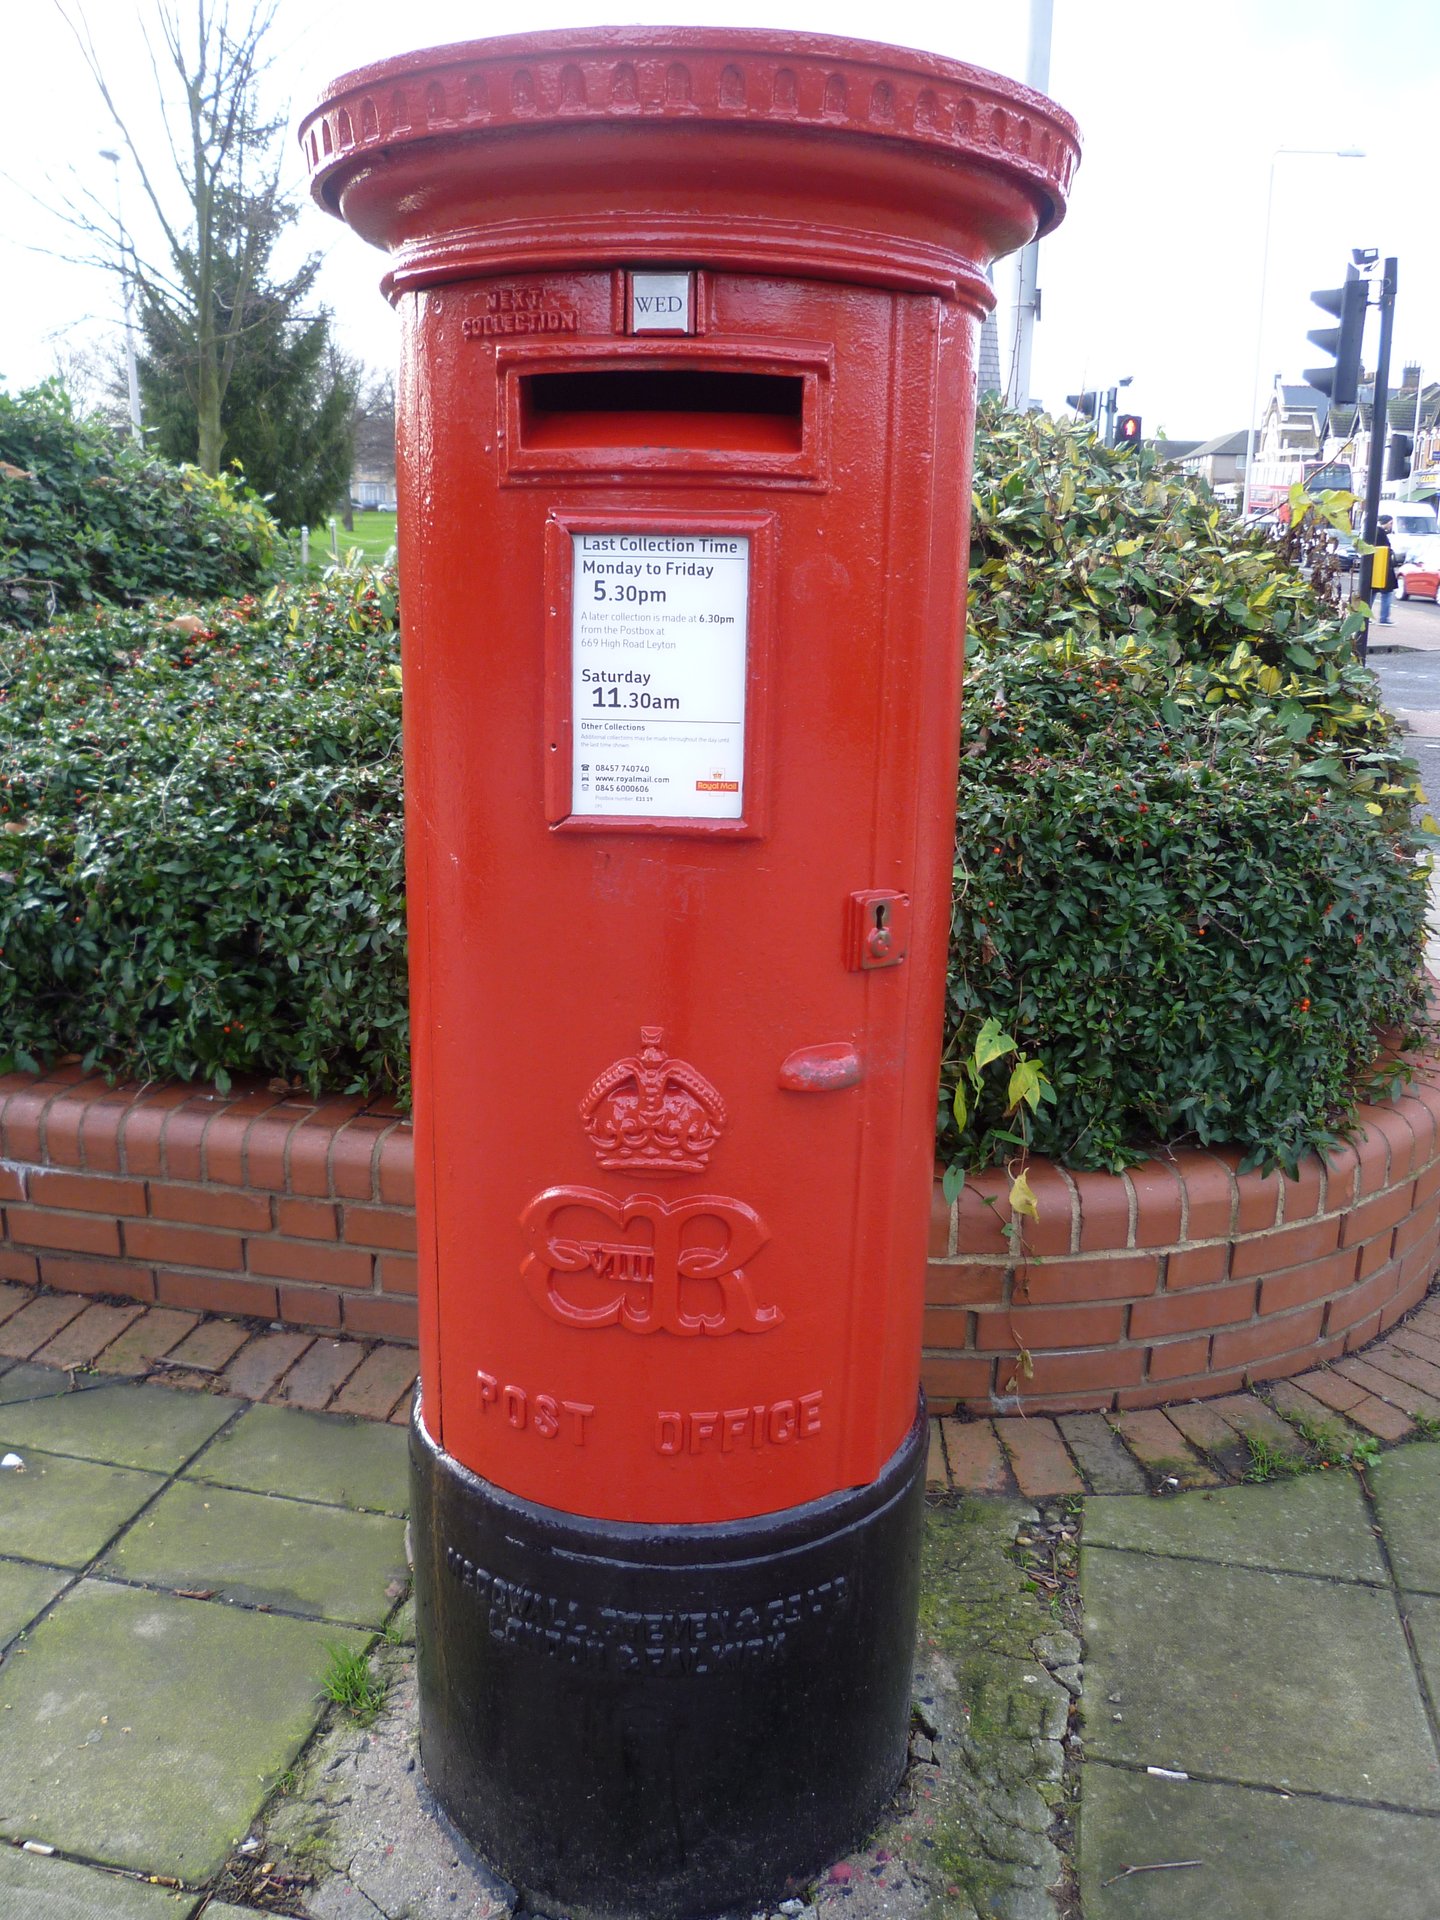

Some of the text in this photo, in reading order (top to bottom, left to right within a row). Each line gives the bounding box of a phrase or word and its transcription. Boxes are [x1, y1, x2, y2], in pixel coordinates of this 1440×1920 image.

[487, 287, 543, 313] NEXT
[635, 296, 683, 313] WED
[462, 309, 579, 338] COLLECTION
[582, 536, 738, 554] Last Collection Time
[582, 560, 714, 579] Monday to Friday
[593, 580, 667, 605] 5.30pm
[581, 612, 735, 625] A later collection is made at 6.30pm
[581, 625, 665, 636] from the Postbox at
[581, 638, 677, 651] 669 High Road Leyton
[582, 669, 651, 687] Saturday
[592, 687, 680, 710] 11.30am
[581, 722, 646, 732] Other Collections
[595, 764, 650, 773] 08457 740740
[595, 776, 670, 784] www.royalmail.com
[595, 784, 650, 793] 0845 6000606
[697, 781, 738, 791] Royal Mail
[476, 1369, 824, 1457] POST OFFICE
